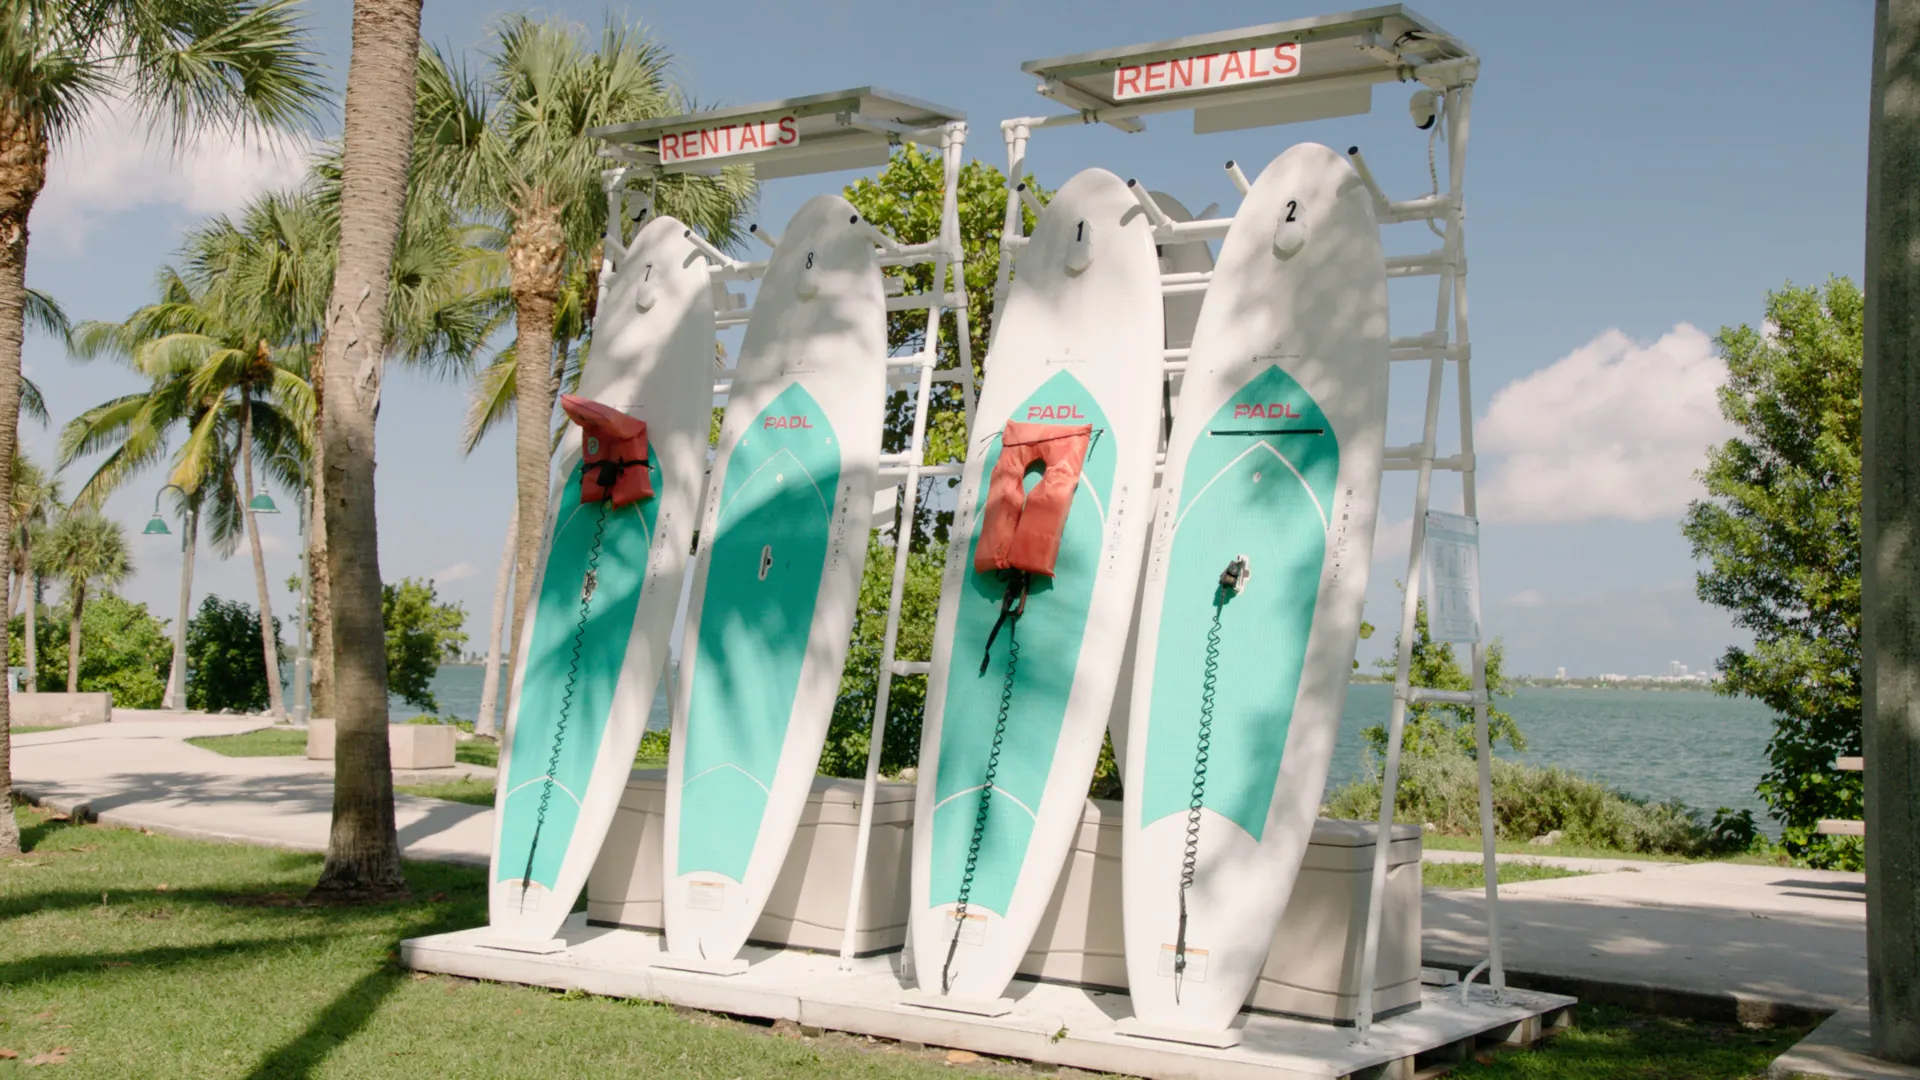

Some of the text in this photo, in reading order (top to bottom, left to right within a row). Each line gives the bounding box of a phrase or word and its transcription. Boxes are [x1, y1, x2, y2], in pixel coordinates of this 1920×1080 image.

[1117, 42, 1297, 96] RENTALS
[662, 116, 797, 161] RENTALS
[1285, 200, 1297, 223] 2
[1076, 220, 1085, 242] 1
[805, 251, 814, 270] 8
[645, 264, 653, 282] 7
[1027, 405, 1085, 420] PADL
[1234, 404, 1300, 419] PADL
[763, 415, 813, 429] PADL
